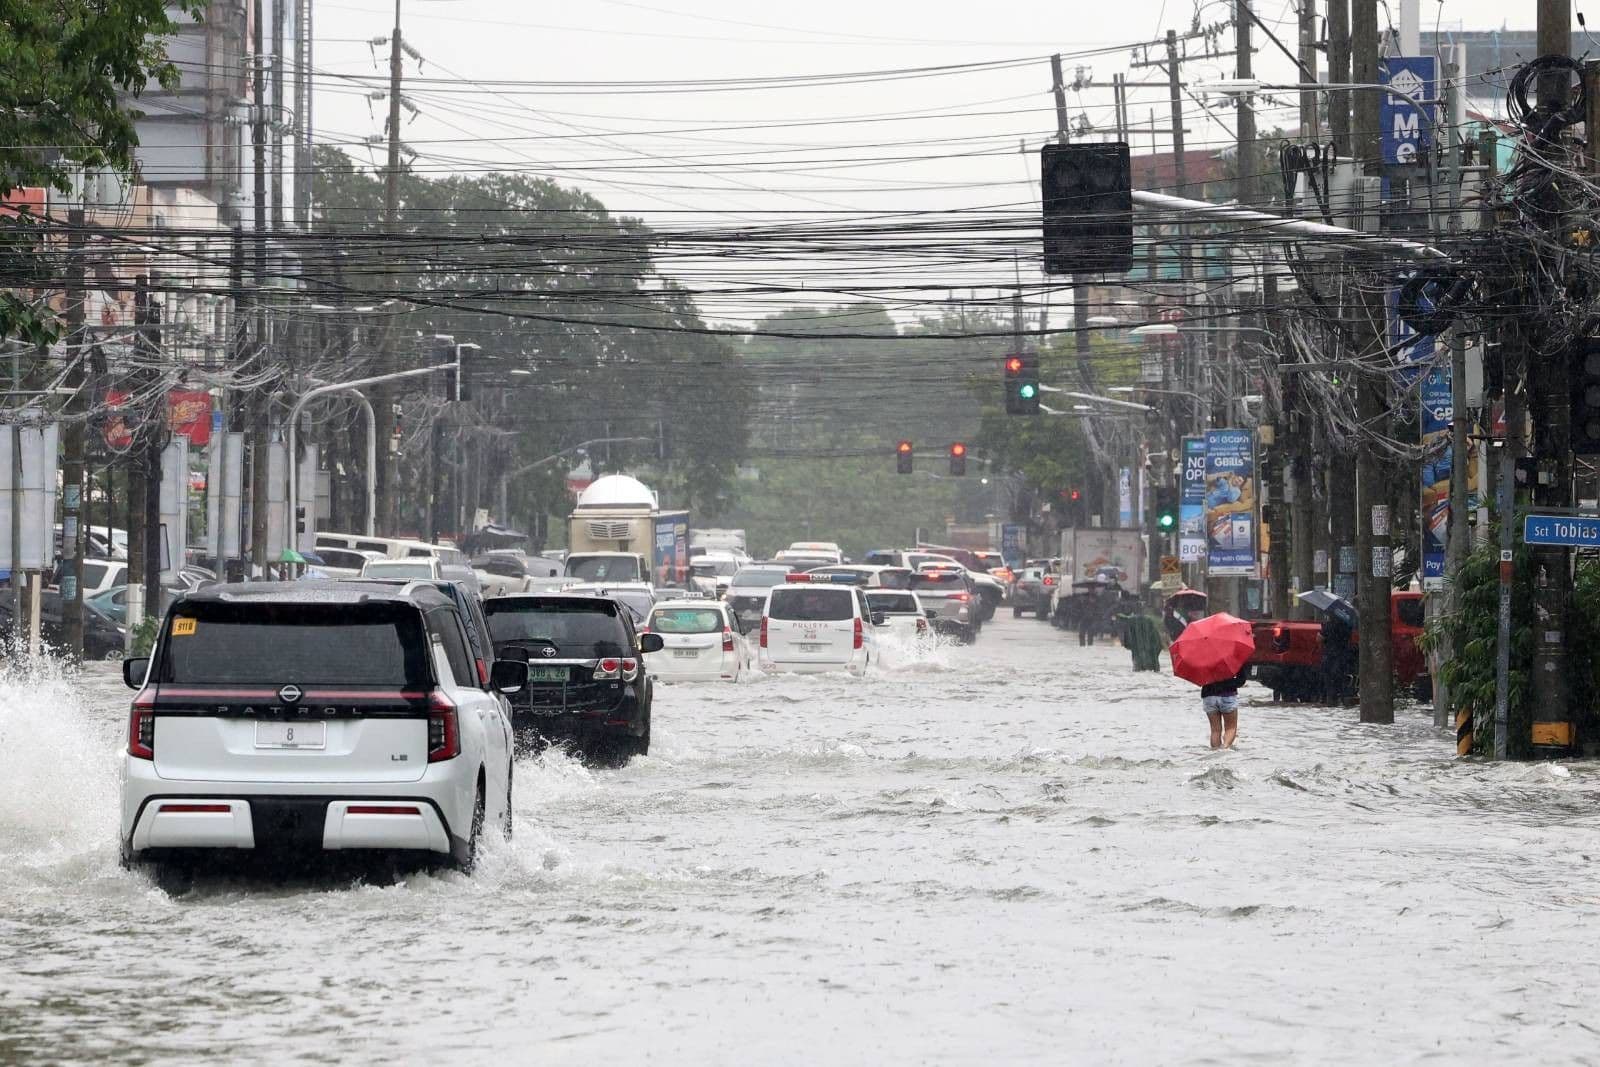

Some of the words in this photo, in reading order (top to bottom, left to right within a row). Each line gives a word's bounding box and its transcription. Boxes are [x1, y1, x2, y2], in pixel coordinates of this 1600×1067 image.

[1534, 526, 1549, 537] Sct
[1554, 522, 1597, 539] Tobias
[1426, 560, 1441, 570] Pay
[217, 706, 362, 715] PATROL
[287, 727, 294, 741] 8
